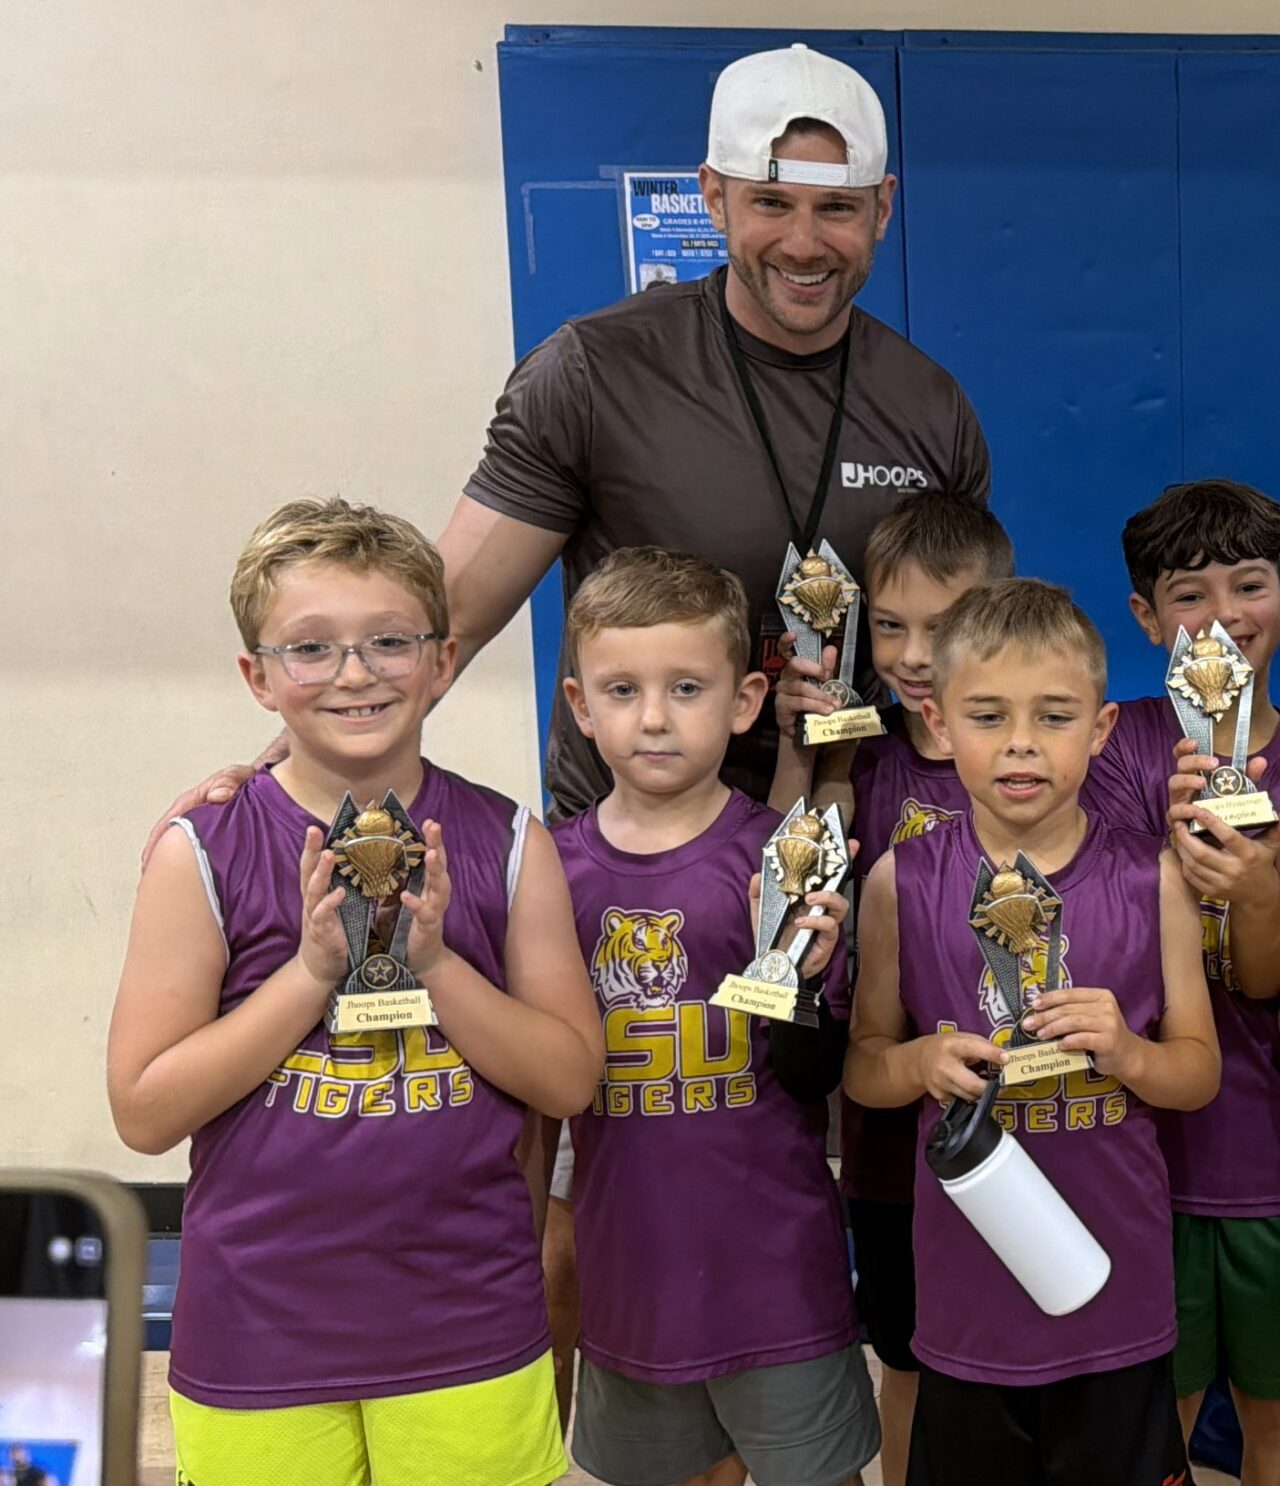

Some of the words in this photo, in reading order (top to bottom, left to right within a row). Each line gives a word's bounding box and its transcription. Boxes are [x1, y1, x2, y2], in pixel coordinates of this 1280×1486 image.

[633, 180, 678, 196] WINTER
[841, 462, 928, 488] JHOOPS
[822, 725, 867, 737] Champion
[346, 1000, 376, 1010] Jhoops
[378, 996, 421, 1007] Basketball
[731, 993, 776, 1010] Champion
[356, 1010, 413, 1023] Champion
[598, 999, 754, 1084] SU
[1020, 1059, 1071, 1075] Champion
[264, 1064, 474, 1119] TIGERS
[990, 1093, 1128, 1134] GERS
